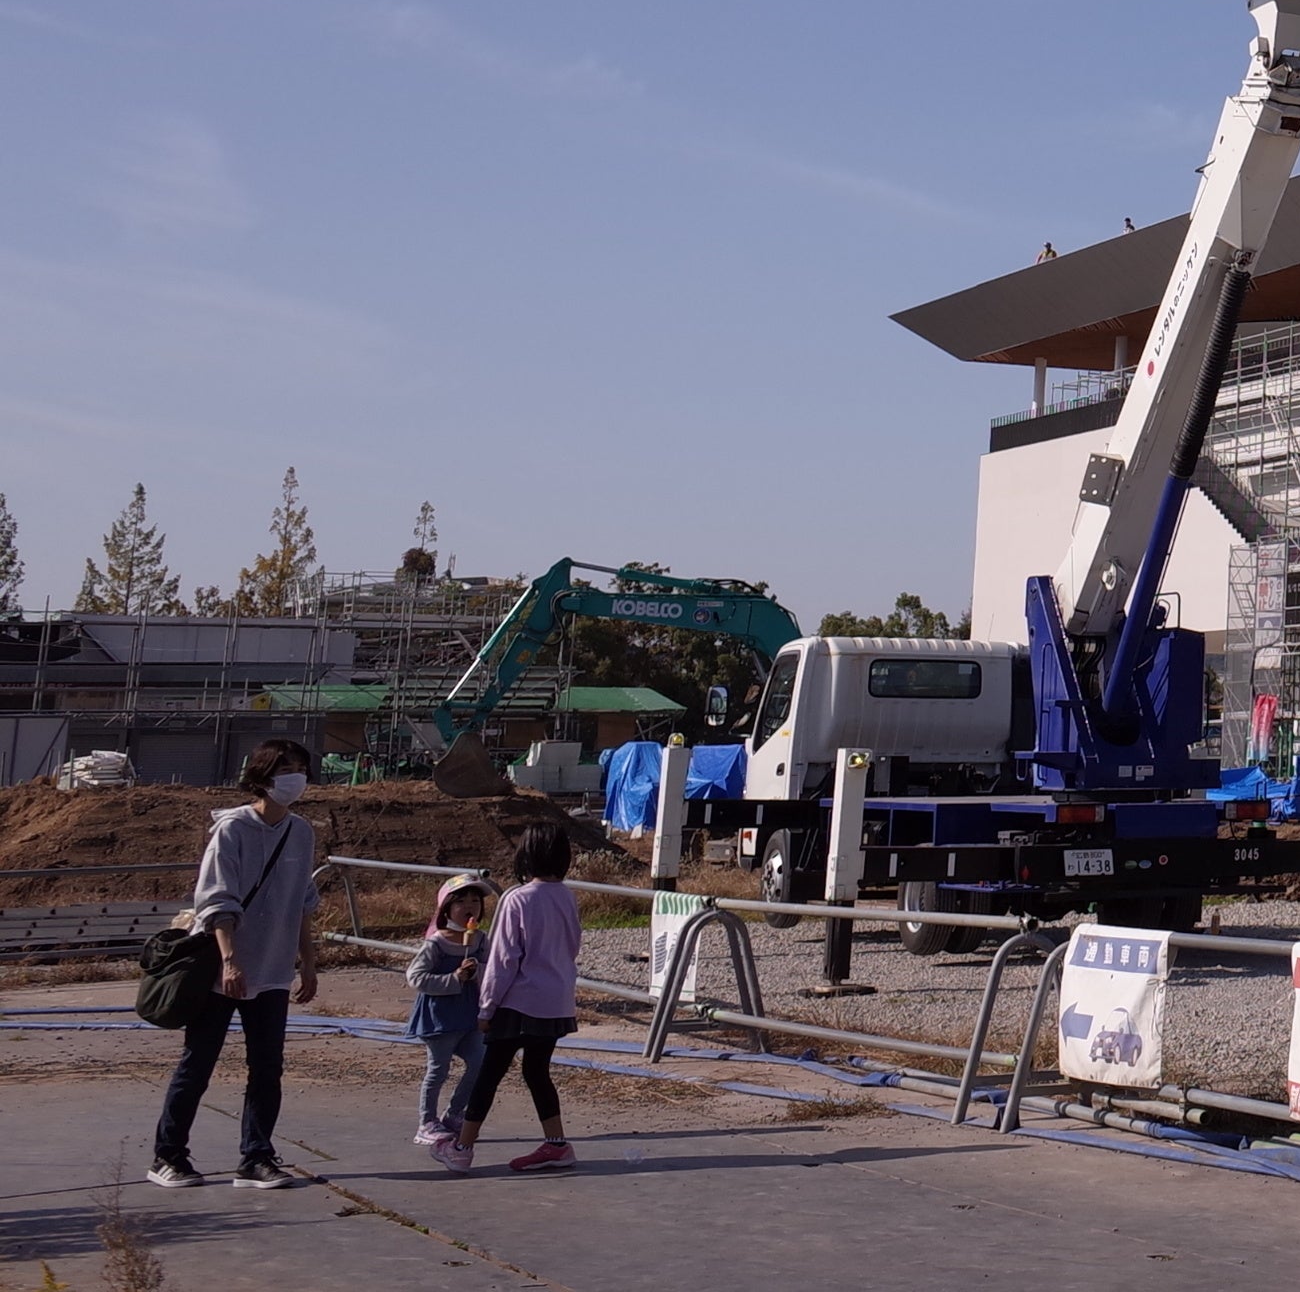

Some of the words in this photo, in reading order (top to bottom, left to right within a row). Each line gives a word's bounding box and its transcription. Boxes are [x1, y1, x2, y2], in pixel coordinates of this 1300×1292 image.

[1154, 241, 1198, 357] レンタルのニッケン
[611, 599, 683, 619] KOBELCO
[1234, 848, 1260, 861] 3045
[1077, 859, 1111, 873] 14-38
[1083, 941, 1150, 968] 通勤車両
